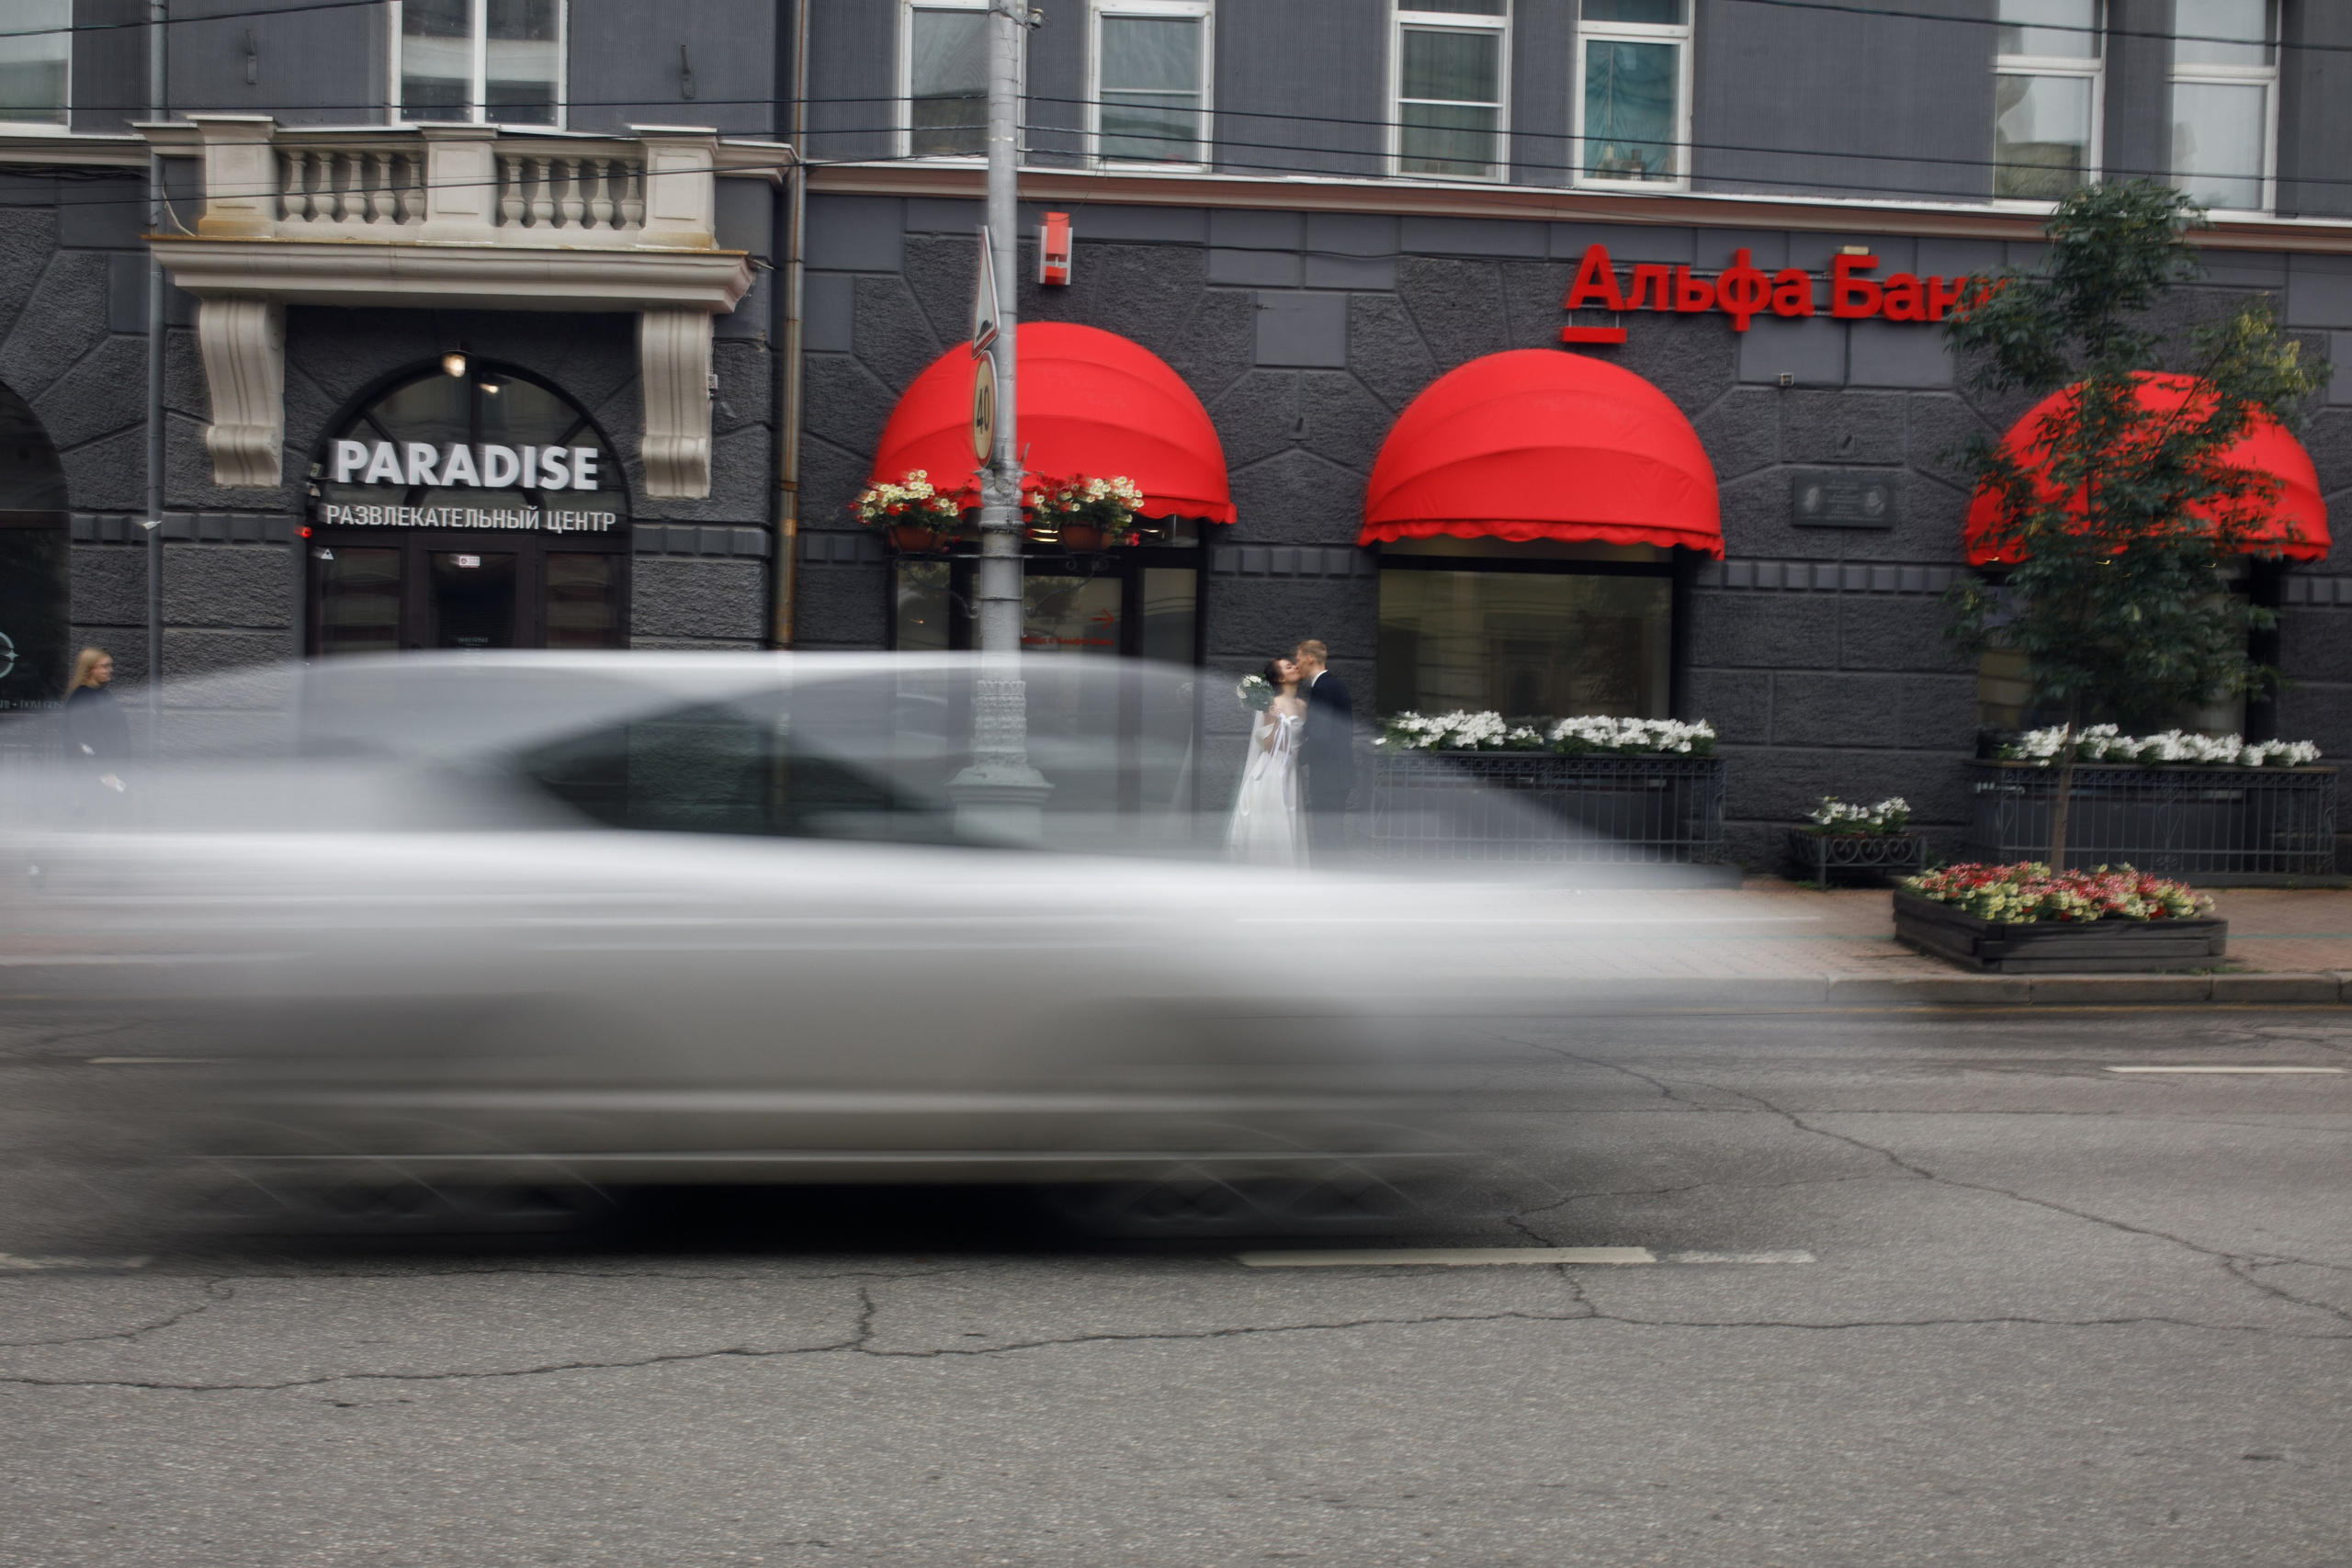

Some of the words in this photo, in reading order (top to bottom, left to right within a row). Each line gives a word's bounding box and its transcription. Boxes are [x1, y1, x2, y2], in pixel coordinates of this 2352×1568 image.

[1566, 243, 1815, 332] Альфа
[977, 385, 990, 434] 40
[336, 440, 599, 491] PARADISE
[326, 504, 540, 530] РАЗВЛЕКАТЕЛЬНЫЙ
[547, 510, 617, 534] ЦЕНТР
